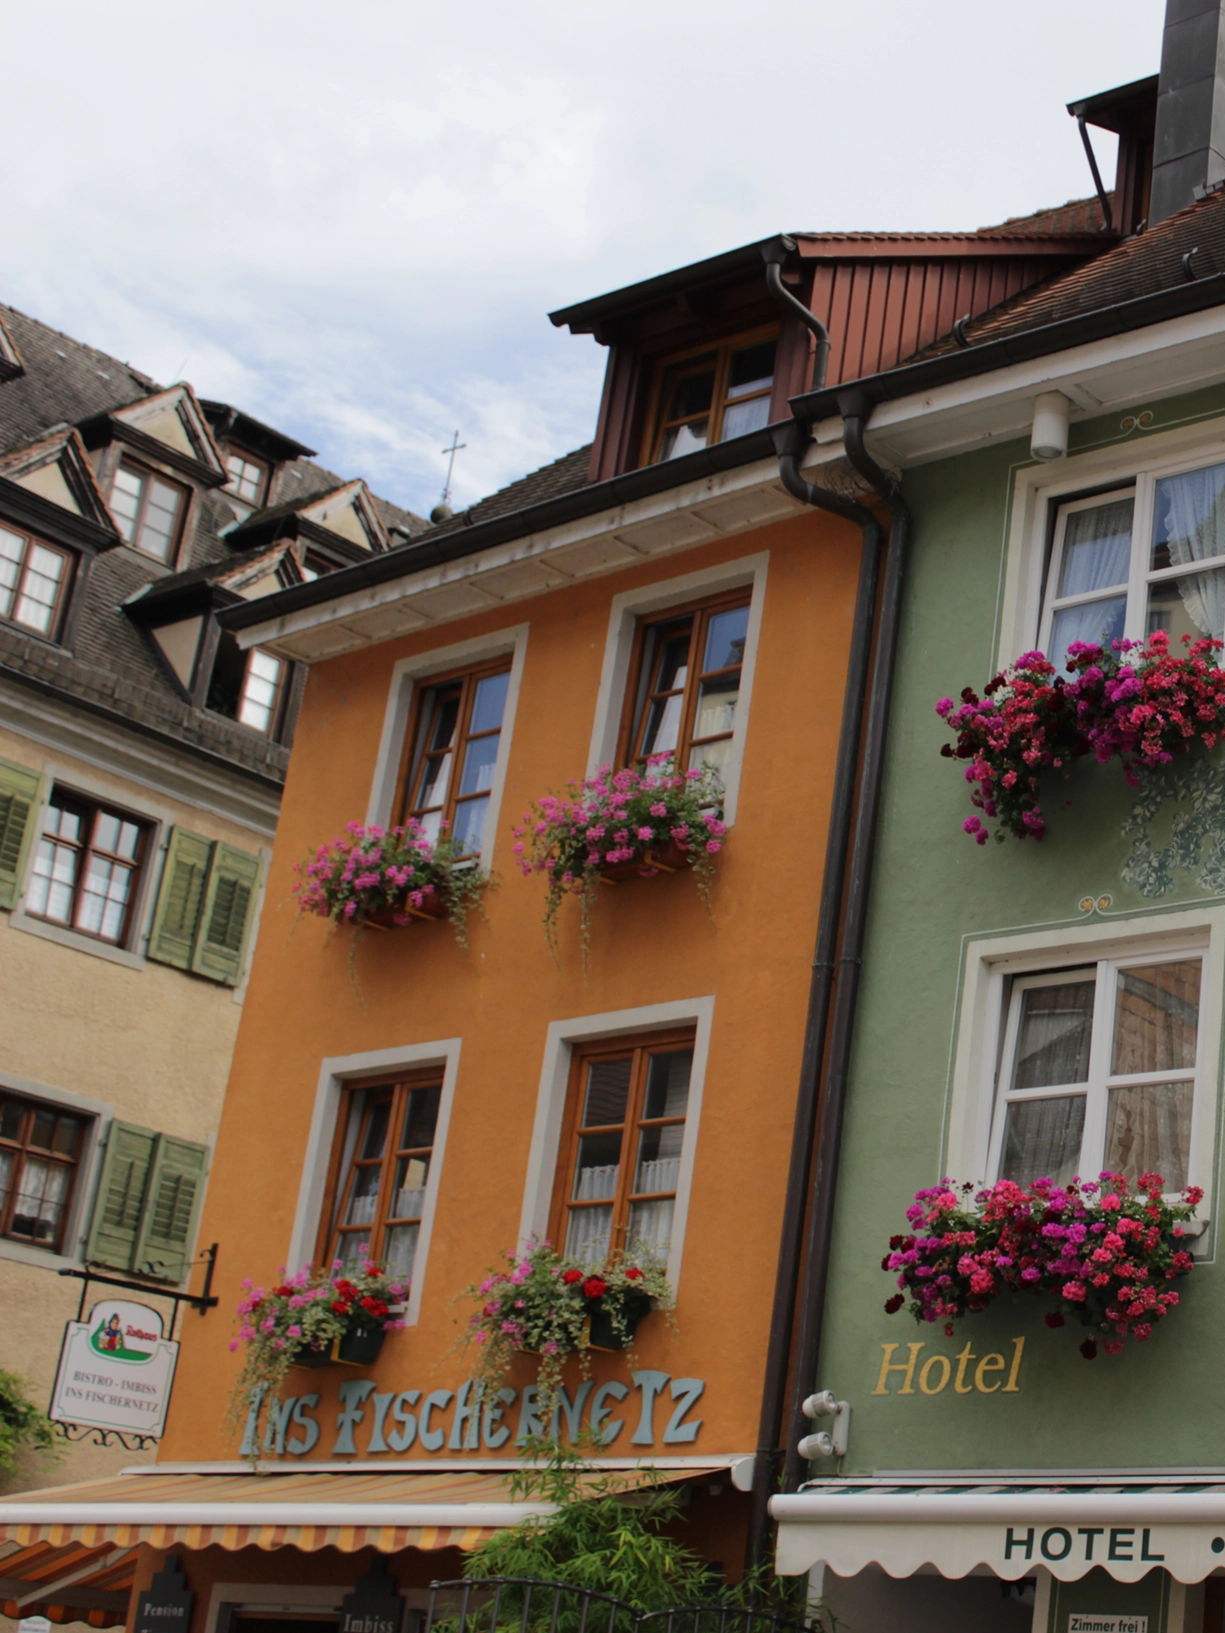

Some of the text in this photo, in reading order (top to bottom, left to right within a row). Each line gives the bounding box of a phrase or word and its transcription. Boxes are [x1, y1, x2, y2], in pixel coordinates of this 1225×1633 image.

[870, 1336, 1026, 1395] Hotel
[73, 1370, 113, 1387] BISTRO
[121, 1380, 157, 1395] IMBISS
[65, 1387, 160, 1413] INS FISCHERNETZ
[1003, 1526, 1165, 1562] HOTEL
[143, 1603, 185, 1616] Pension
[343, 1613, 394, 1633] Imbiss
[1071, 1618, 1115, 1632] Zimmer
